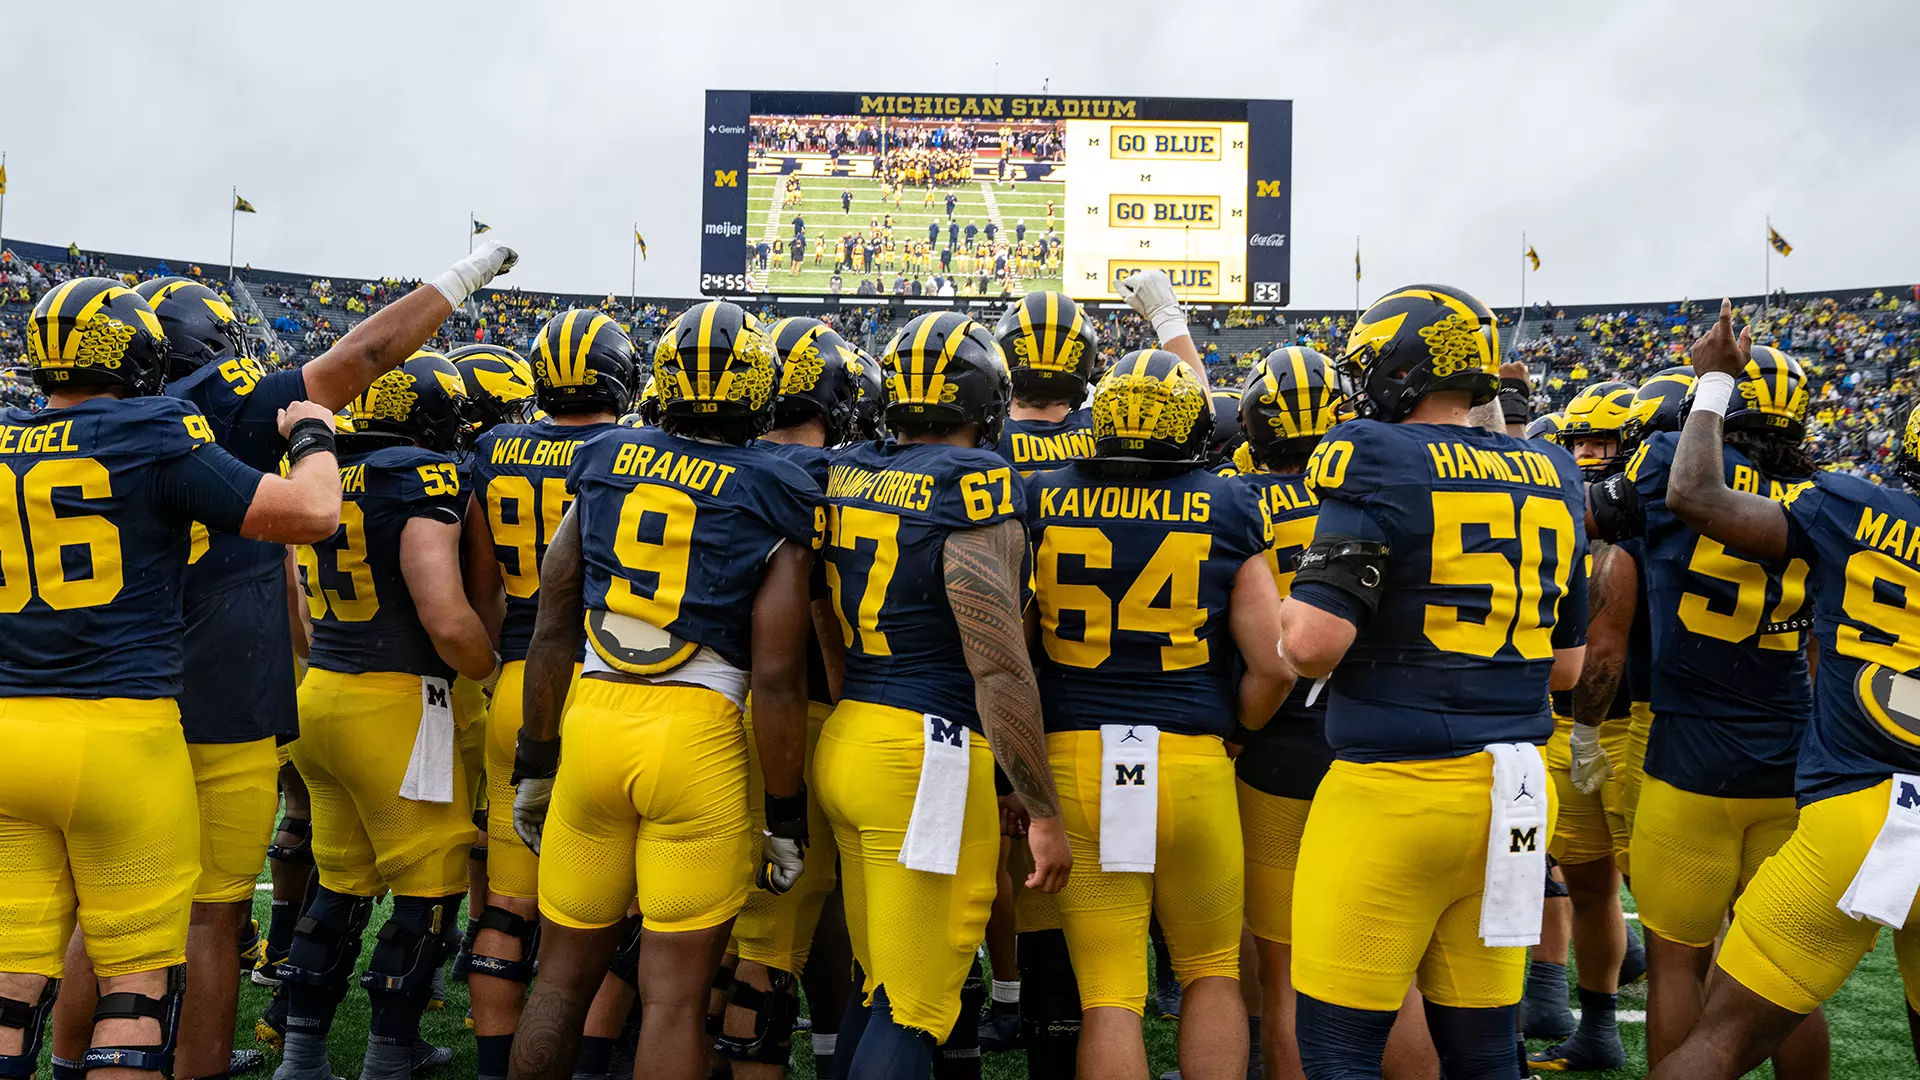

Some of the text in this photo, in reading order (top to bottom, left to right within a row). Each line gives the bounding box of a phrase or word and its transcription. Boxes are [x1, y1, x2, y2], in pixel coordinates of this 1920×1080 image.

[861, 95, 1137, 118] MICHIGAN STADIUM
[718, 125, 746, 135] Gemini
[1088, 138, 1100, 146] M
[1118, 134, 1214, 153] GO BLUE
[1232, 140, 1244, 149] M
[714, 170, 739, 188] M
[1140, 174, 1152, 182] M
[1256, 180, 1281, 198] M
[1087, 207, 1099, 215] M
[1117, 202, 1213, 221] GO BLUE
[1231, 209, 1243, 217] M
[705, 222, 743, 237] meijer
[1139, 240, 1151, 248] M
[701, 274, 745, 290] 24:55
[1086, 272, 1098, 280] M
[1163, 268, 1212, 287] LUE
[1230, 274, 1242, 283] M
[1256, 284, 1278, 300] 25
[0, 420, 79, 454] EIGEL
[612, 443, 737, 497] BRANDT
[1426, 442, 1562, 489] HAMILTON
[416, 462, 460, 497] 53
[959, 466, 1015, 522] 67
[1039, 486, 1212, 523] KAVOUKLIS
[811, 505, 827, 550] 9
[604, 483, 698, 629] 9
[1422, 491, 1577, 660] 50
[1036, 525, 1213, 672] 64
[427, 684, 448, 709] M
[930, 717, 963, 748] M
[1114, 763, 1146, 786] M
[1508, 825, 1538, 853] M
[86, 1052, 124, 1062] DONJOY
